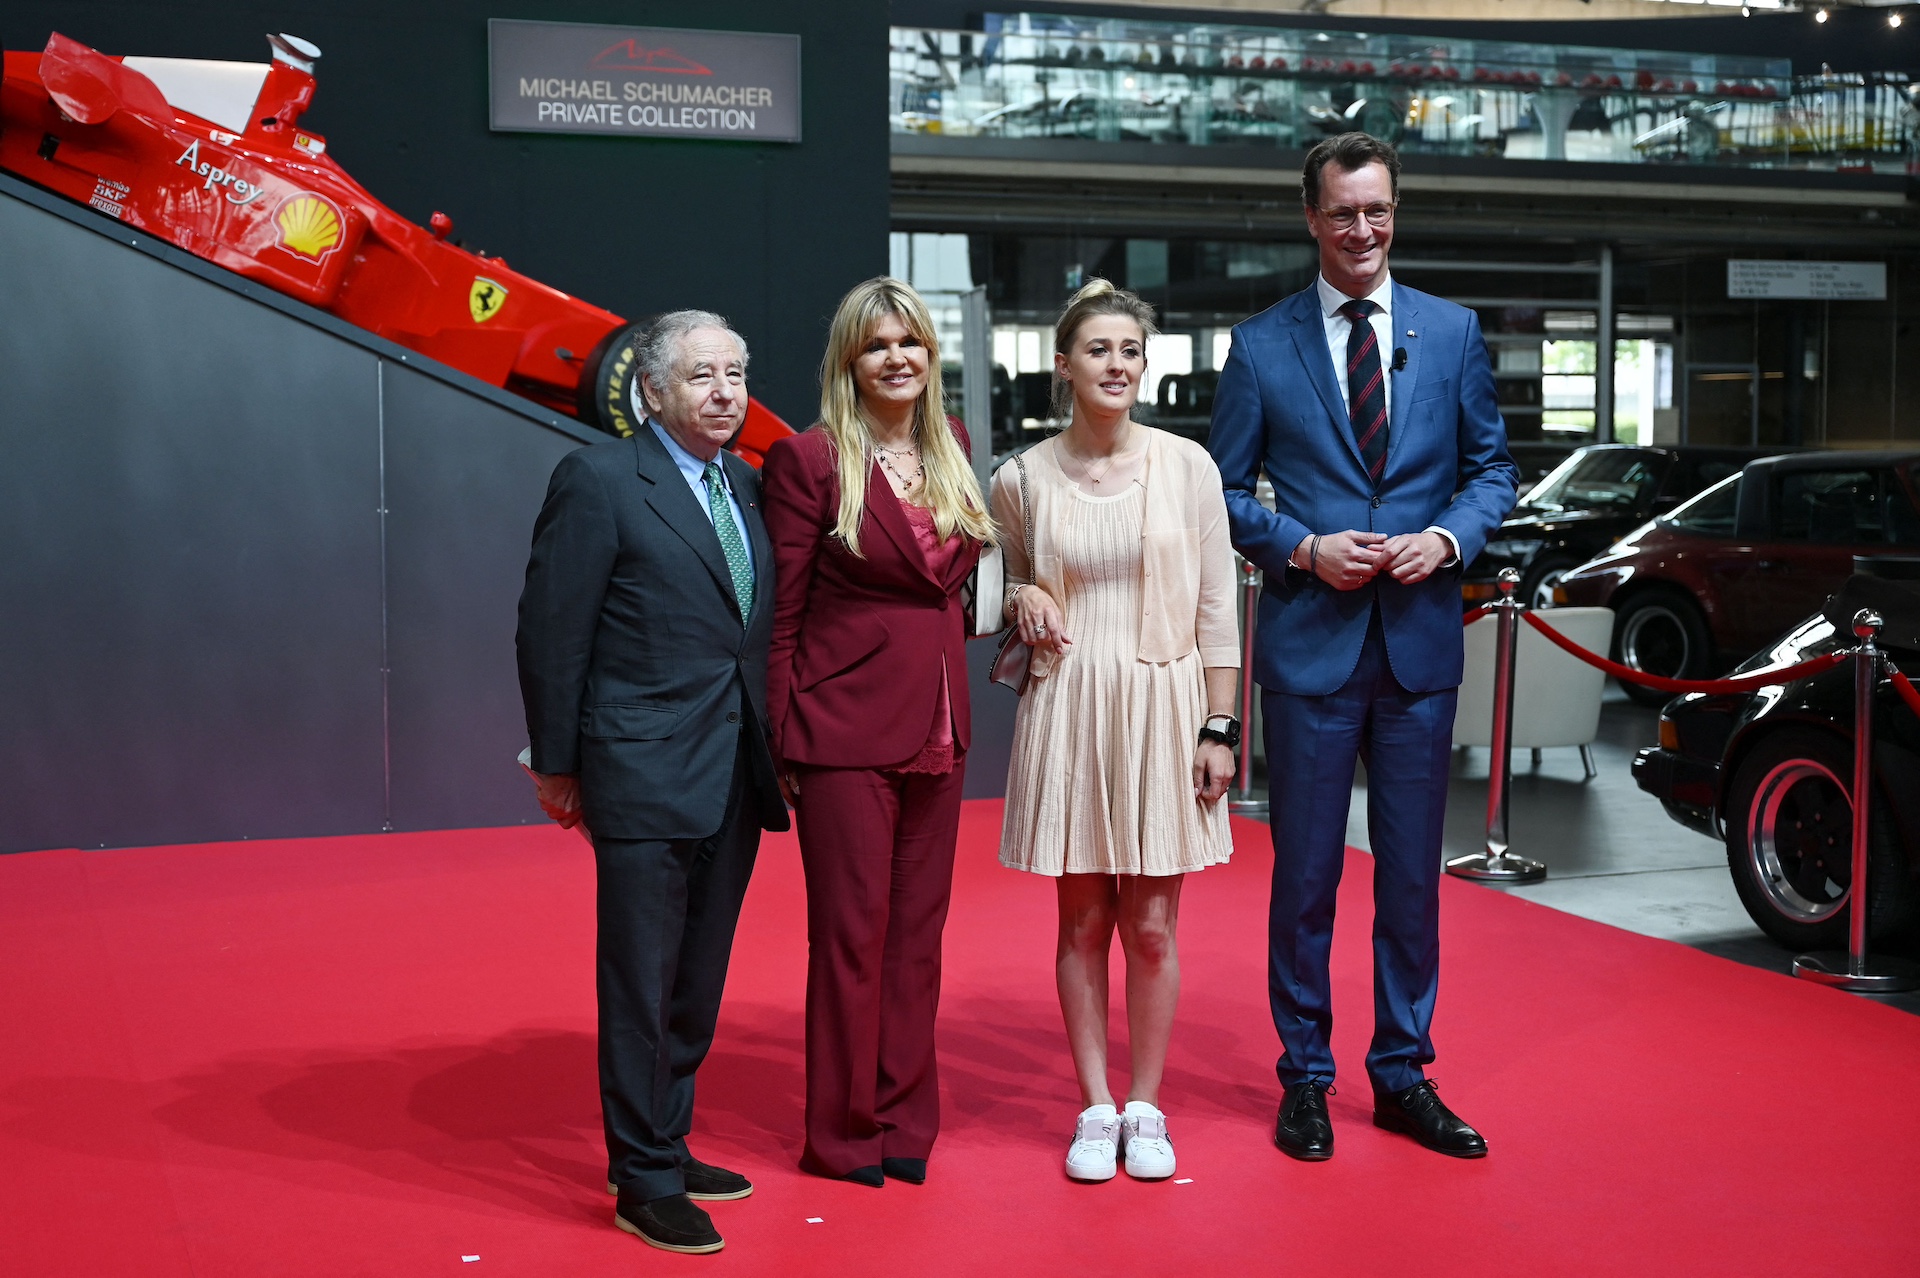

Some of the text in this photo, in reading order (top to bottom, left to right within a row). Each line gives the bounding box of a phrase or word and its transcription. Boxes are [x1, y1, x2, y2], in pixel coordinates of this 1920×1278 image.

[520, 78, 773, 107] MICHAEL SCHUMACHER
[538, 102, 756, 131] PRIVATE COLLECTION
[175, 138, 264, 205] Asprey
[93, 184, 127, 201] SKF
